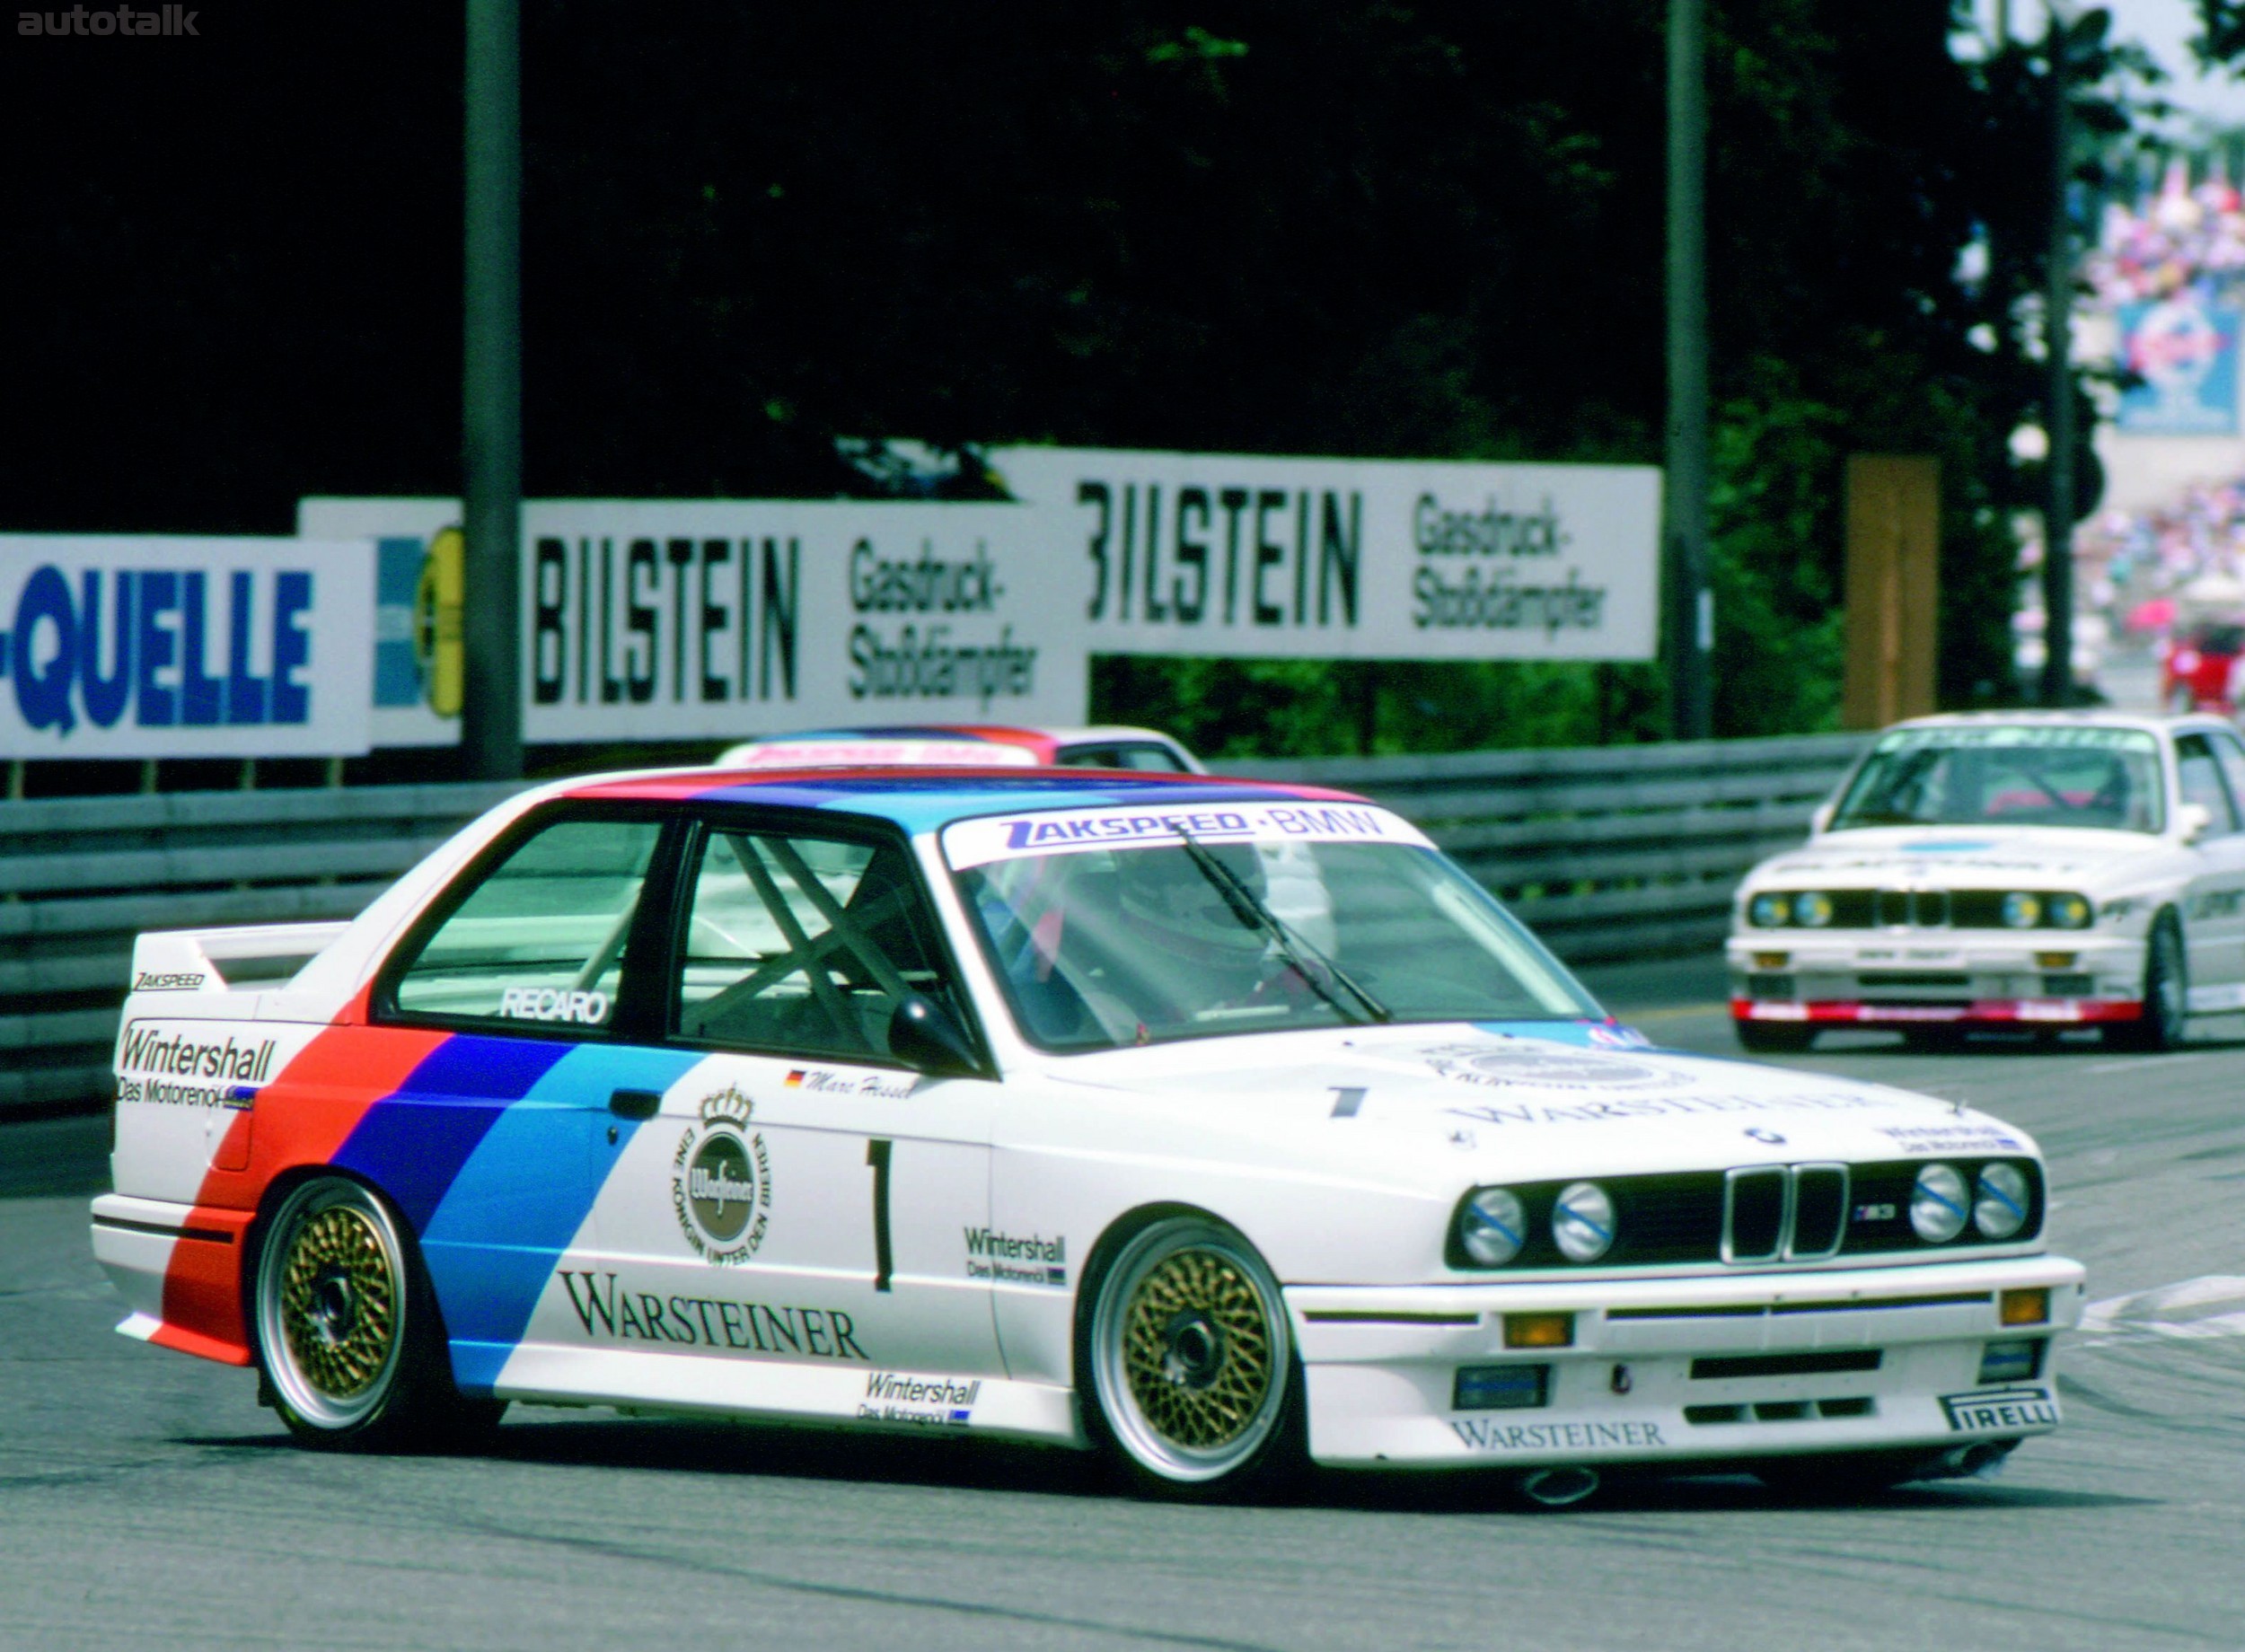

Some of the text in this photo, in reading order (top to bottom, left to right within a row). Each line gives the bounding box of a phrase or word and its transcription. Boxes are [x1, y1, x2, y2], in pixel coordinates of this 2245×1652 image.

[1413, 491, 1573, 558] Gasdruck-
[850, 537, 1006, 613] Gasdruck-
[533, 536, 801, 706] BILSTEIN
[1412, 566, 1607, 643] Stoßdämpfer
[847, 623, 1040, 716] Stoßdämpfer
[999, 807, 1384, 849] ZAKSPEED BMW
[134, 972, 206, 992] ZAKSPEED
[499, 987, 608, 1024] RECARO
[121, 1028, 277, 1083] Wintershall
[117, 1076, 142, 1103] Das
[867, 1138, 894, 1293] 1
[964, 1226, 1066, 1262] Wintershall
[557, 1270, 871, 1360] WARSTEINER
[866, 1372, 982, 1405] Wintershall
[1937, 1388, 2057, 1431] PIRELLI
[1450, 1419, 1666, 1450] WARSTEINER
